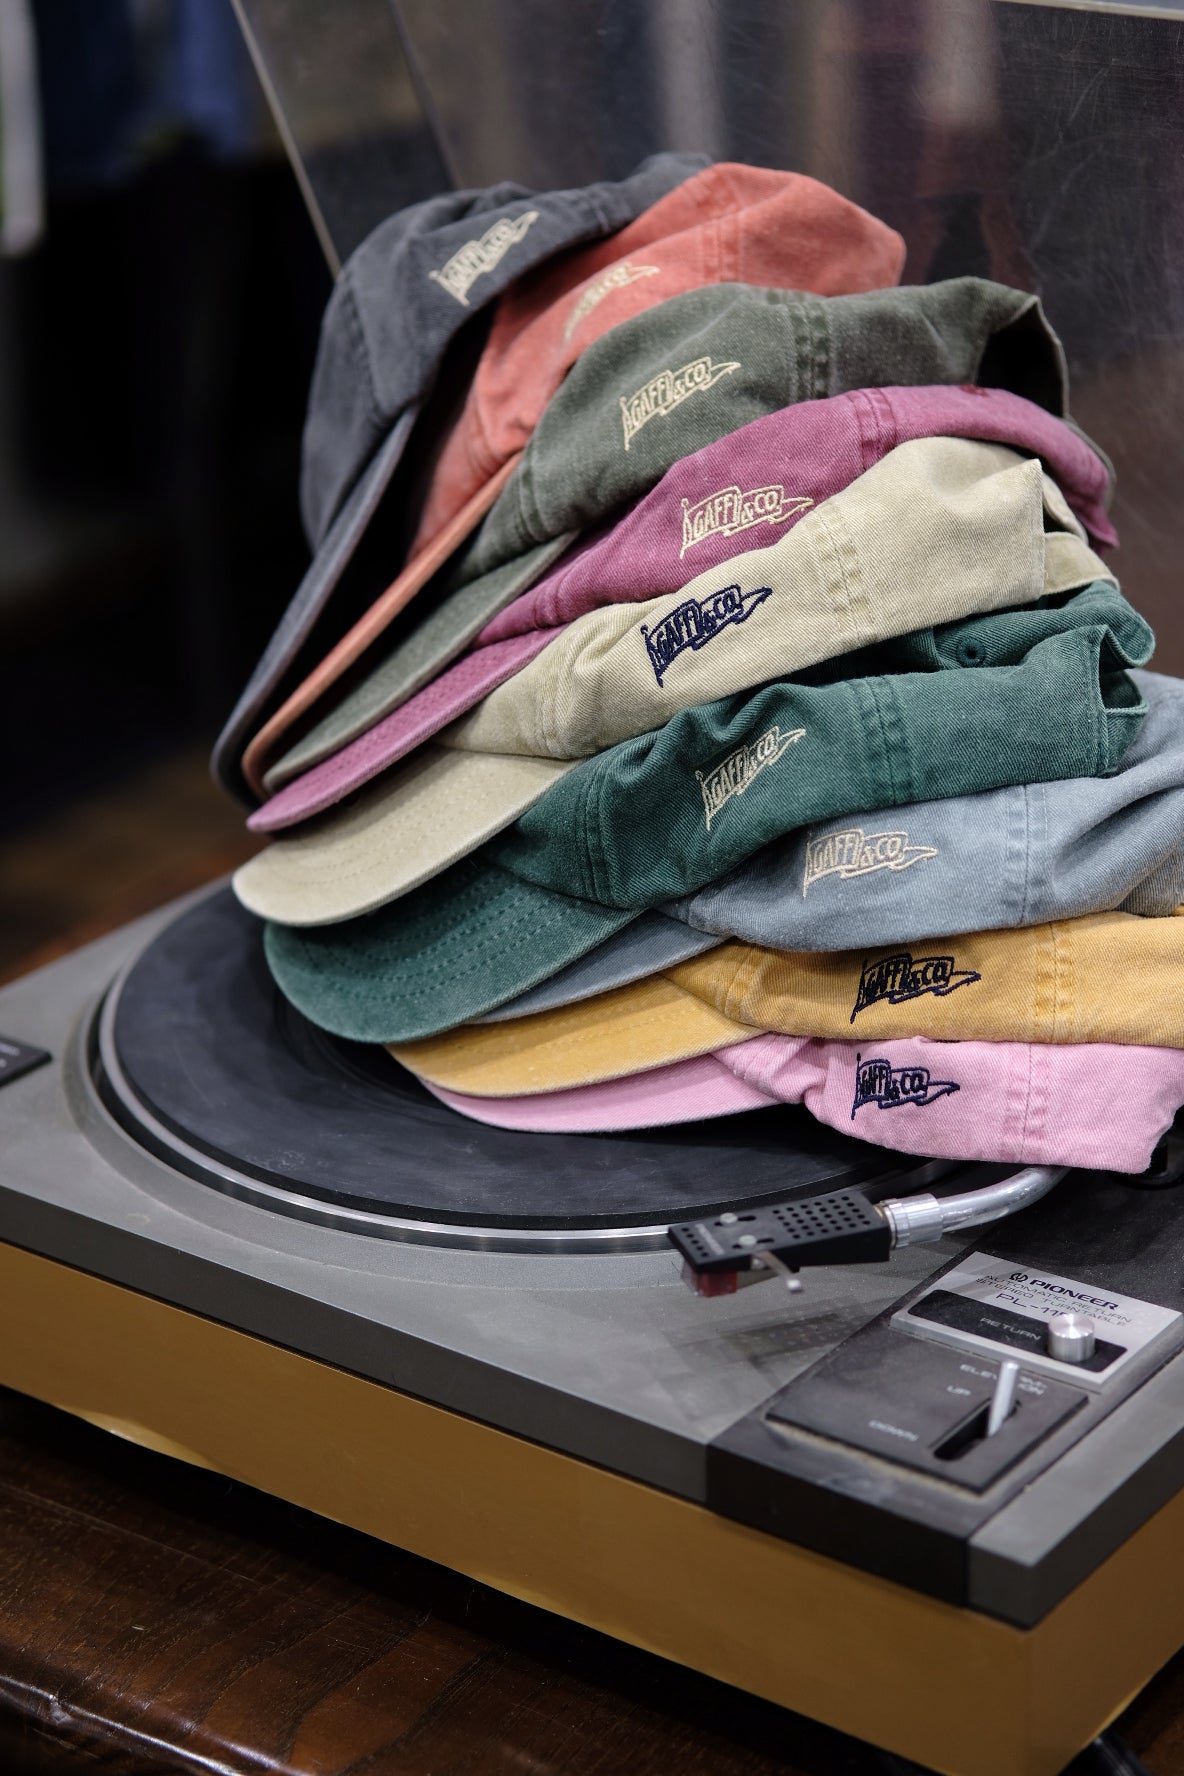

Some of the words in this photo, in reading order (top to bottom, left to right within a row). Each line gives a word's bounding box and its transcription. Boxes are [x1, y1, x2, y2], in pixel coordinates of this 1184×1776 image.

[975, 1278, 1035, 1299] STEREO
[984, 1275, 1067, 1303] AUTOMATIC
[1071, 1301, 1132, 1323] RETURN
[1029, 1279, 1119, 1310] PIONEER
[996, 1293, 1068, 1317] PL-11
[980, 1317, 1042, 1341] RETURN
[947, 1385, 971, 1396] UP
